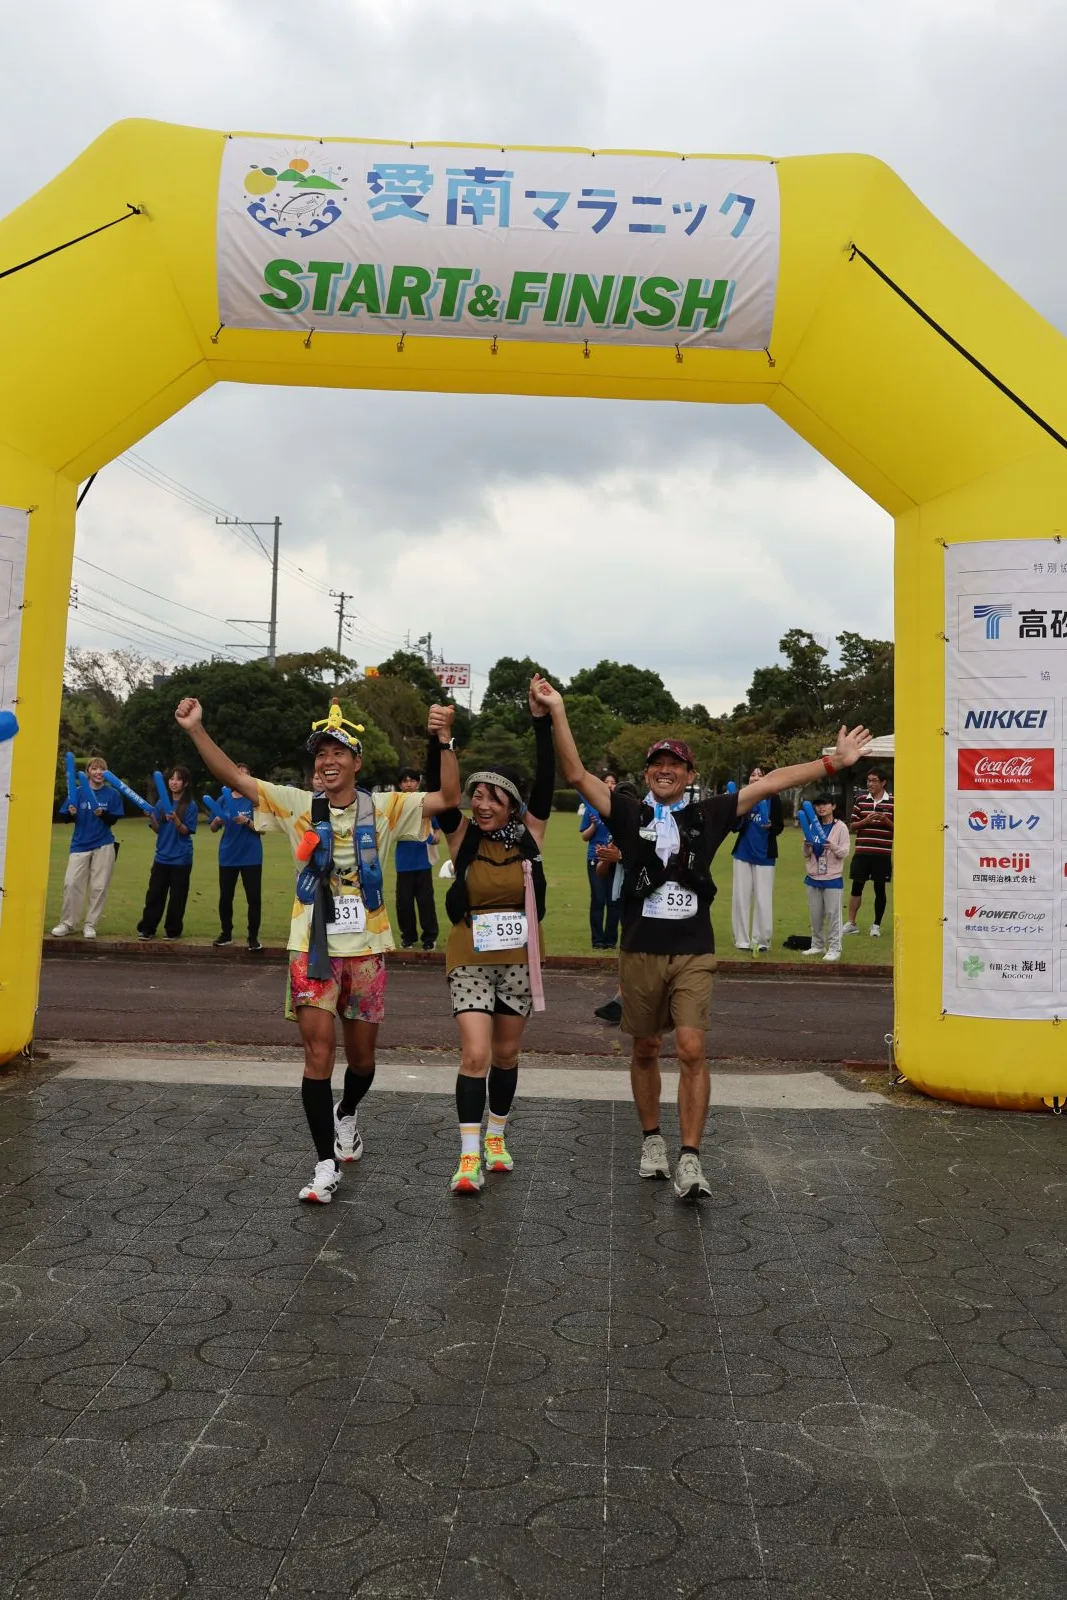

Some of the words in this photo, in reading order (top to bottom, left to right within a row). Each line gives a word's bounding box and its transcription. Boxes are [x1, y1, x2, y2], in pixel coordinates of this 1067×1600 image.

[366, 162, 756, 239] 愛南マラニック
[964, 709, 1048, 729] NIKKEI
[974, 756, 1036, 776] Coca-Cola
[990, 814, 1041, 831] 南レク
[979, 852, 1031, 873] meiji
[972, 874, 1038, 884] 四国明治株式会社
[666, 892, 693, 907] 532
[496, 922, 523, 937] 539
[988, 962, 1019, 972] 有限会社
